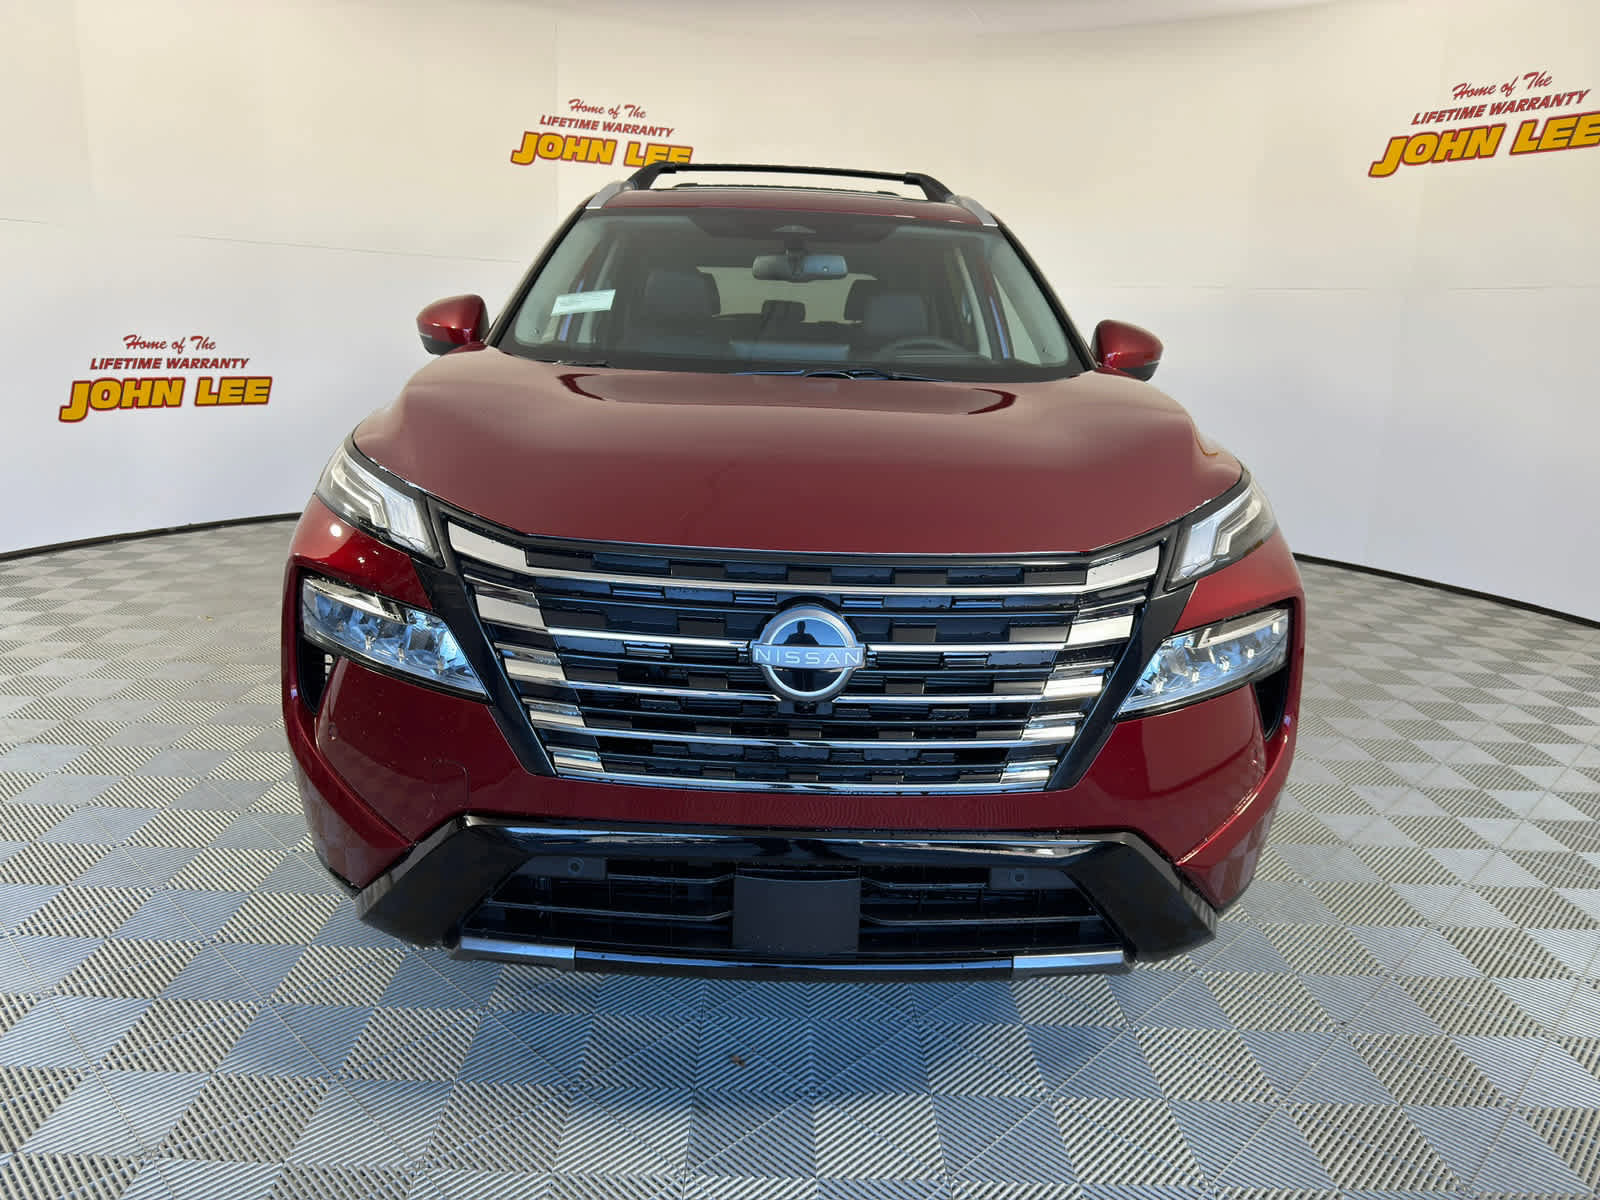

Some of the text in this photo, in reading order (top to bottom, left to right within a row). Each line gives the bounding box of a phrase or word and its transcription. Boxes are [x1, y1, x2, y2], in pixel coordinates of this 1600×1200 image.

[1452, 71, 1552, 100] Home of The
[568, 98, 646, 119] Home of The
[1411, 89, 1591, 125] LIFETIME WARRANTY
[540, 115, 674, 138] LIFETIME WARRANTY
[510, 131, 693, 167] JOHN LEE
[1368, 110, 1600, 178] JOHN LEE
[123, 334, 216, 354] Home of The
[90, 357, 250, 370] LIFETIME WARRANTY
[58, 376, 273, 423] JOHN LEE
[755, 648, 860, 665] NISSAN
